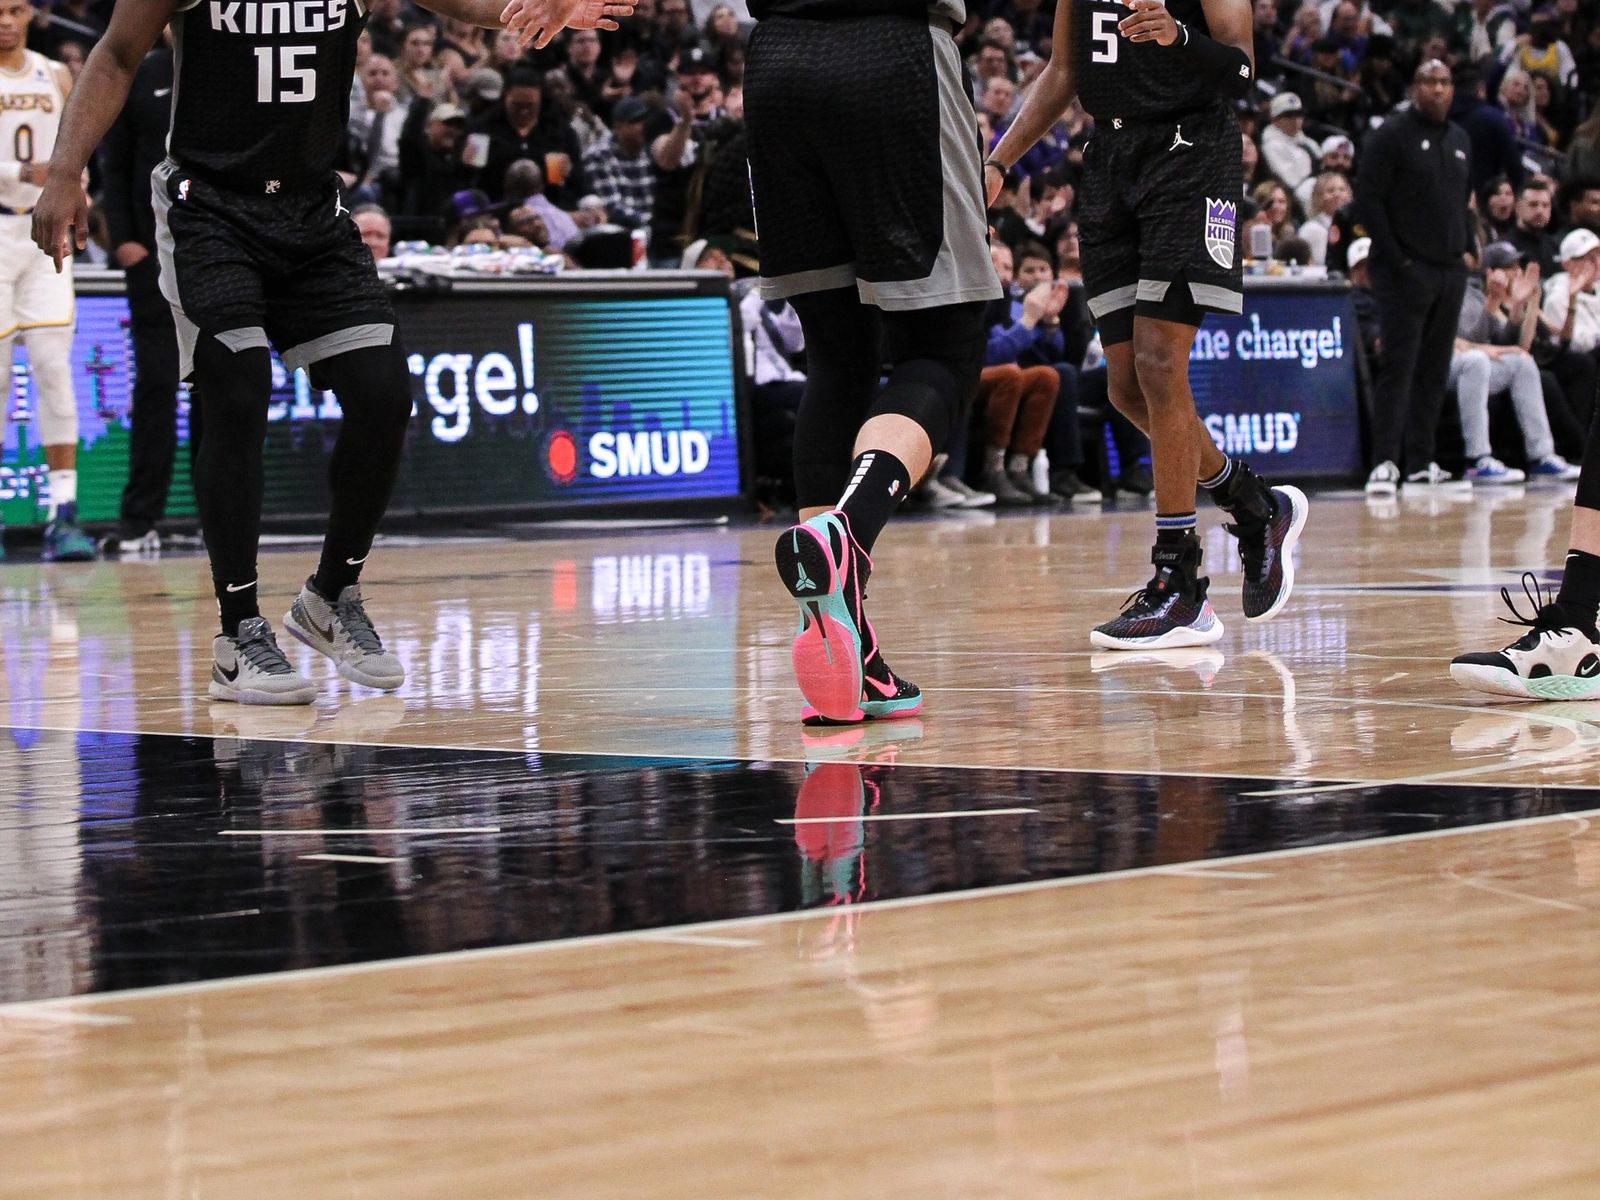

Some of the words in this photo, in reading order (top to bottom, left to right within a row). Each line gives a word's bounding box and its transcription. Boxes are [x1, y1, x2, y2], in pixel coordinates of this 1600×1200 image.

[1092, 12, 1119, 63] 5
[254, 46, 317, 103] 15
[14, 124, 33, 162] 0
[1236, 312, 1343, 368] charge!
[588, 430, 711, 478] SMUD
[1205, 412, 1300, 454] SMUD
